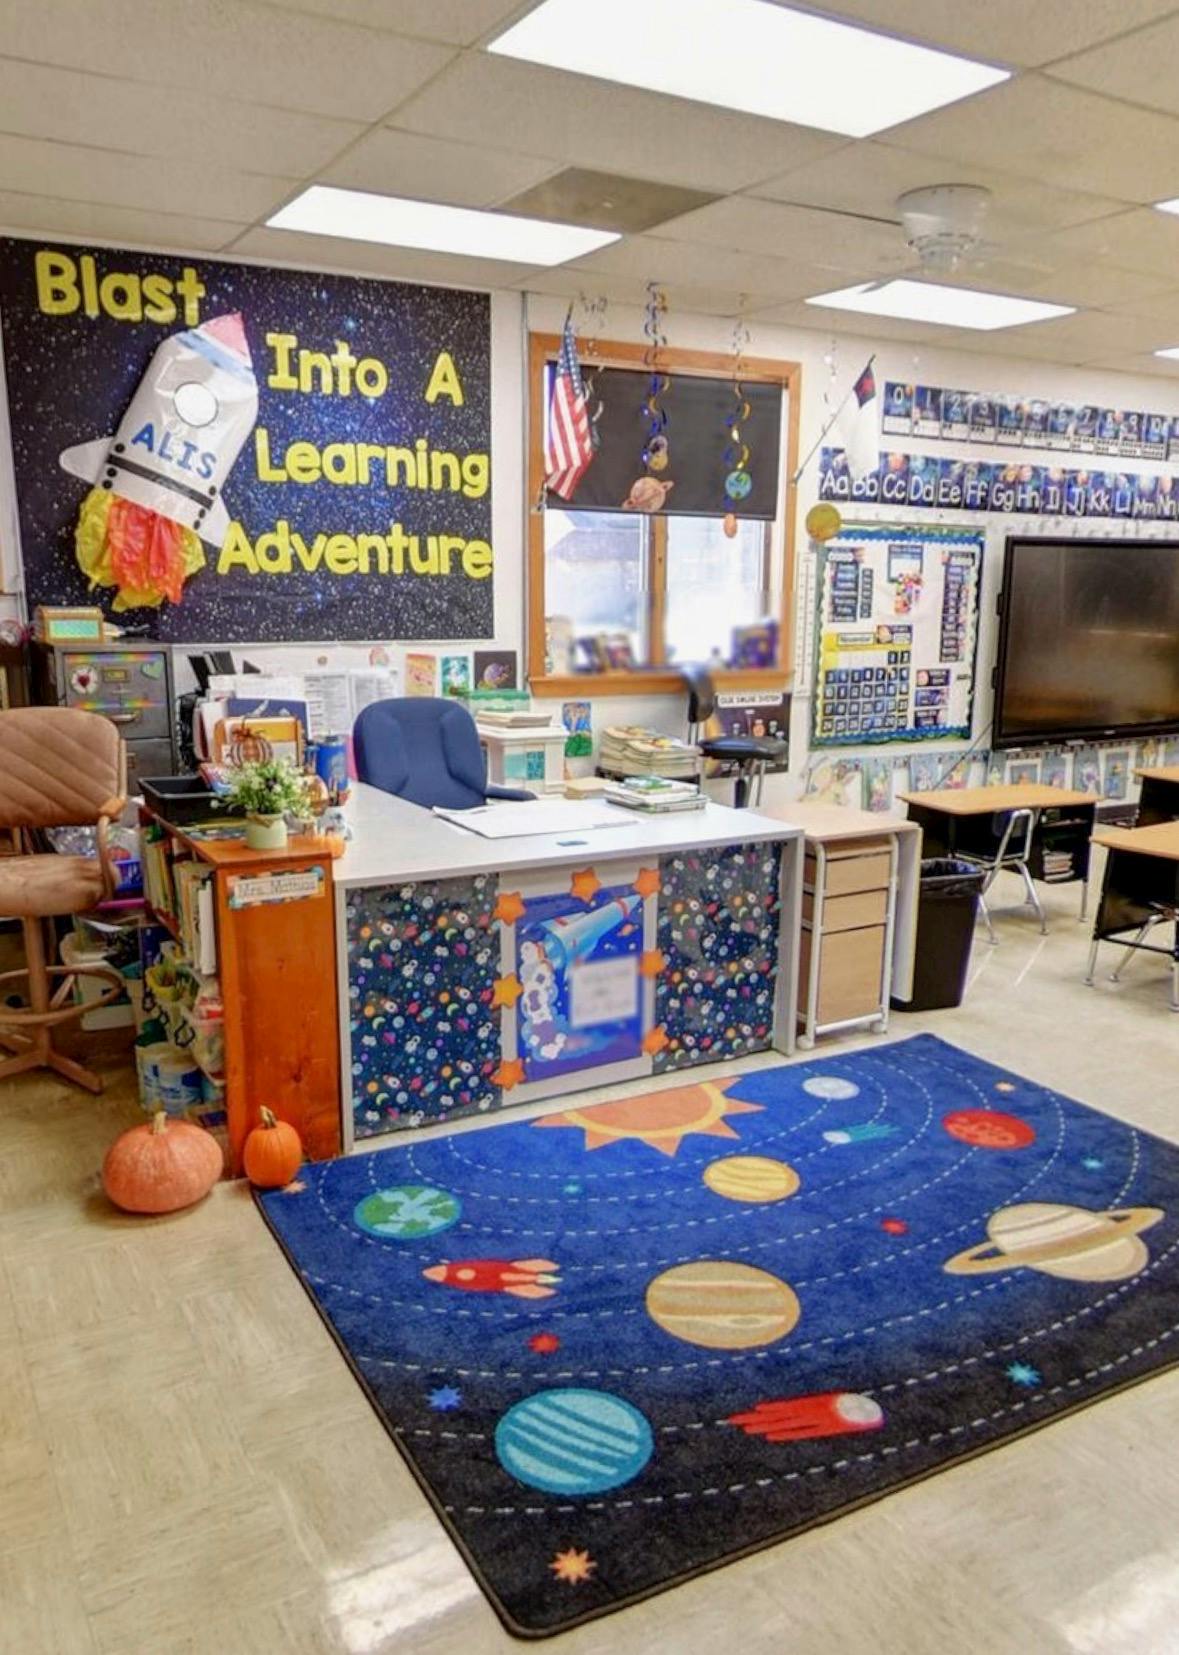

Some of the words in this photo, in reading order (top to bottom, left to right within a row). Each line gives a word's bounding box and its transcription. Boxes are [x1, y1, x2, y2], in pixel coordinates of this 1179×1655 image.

[35, 250, 206, 328] Blast
[265, 332, 389, 399] Into
[424, 352, 464, 406] A
[131, 422, 217, 480] ALIS
[255, 428, 490, 499] Learning
[822, 470, 849, 495] Aa
[882, 473, 906, 500] Cc
[910, 476, 935, 502] Dd
[938, 479, 961, 503] Ee
[966, 480, 988, 506] Ff
[992, 483, 1014, 512] Gg
[1017, 485, 1040, 508] Hh
[1089, 490, 1110, 512] Kk
[217, 520, 494, 580] Adventure
